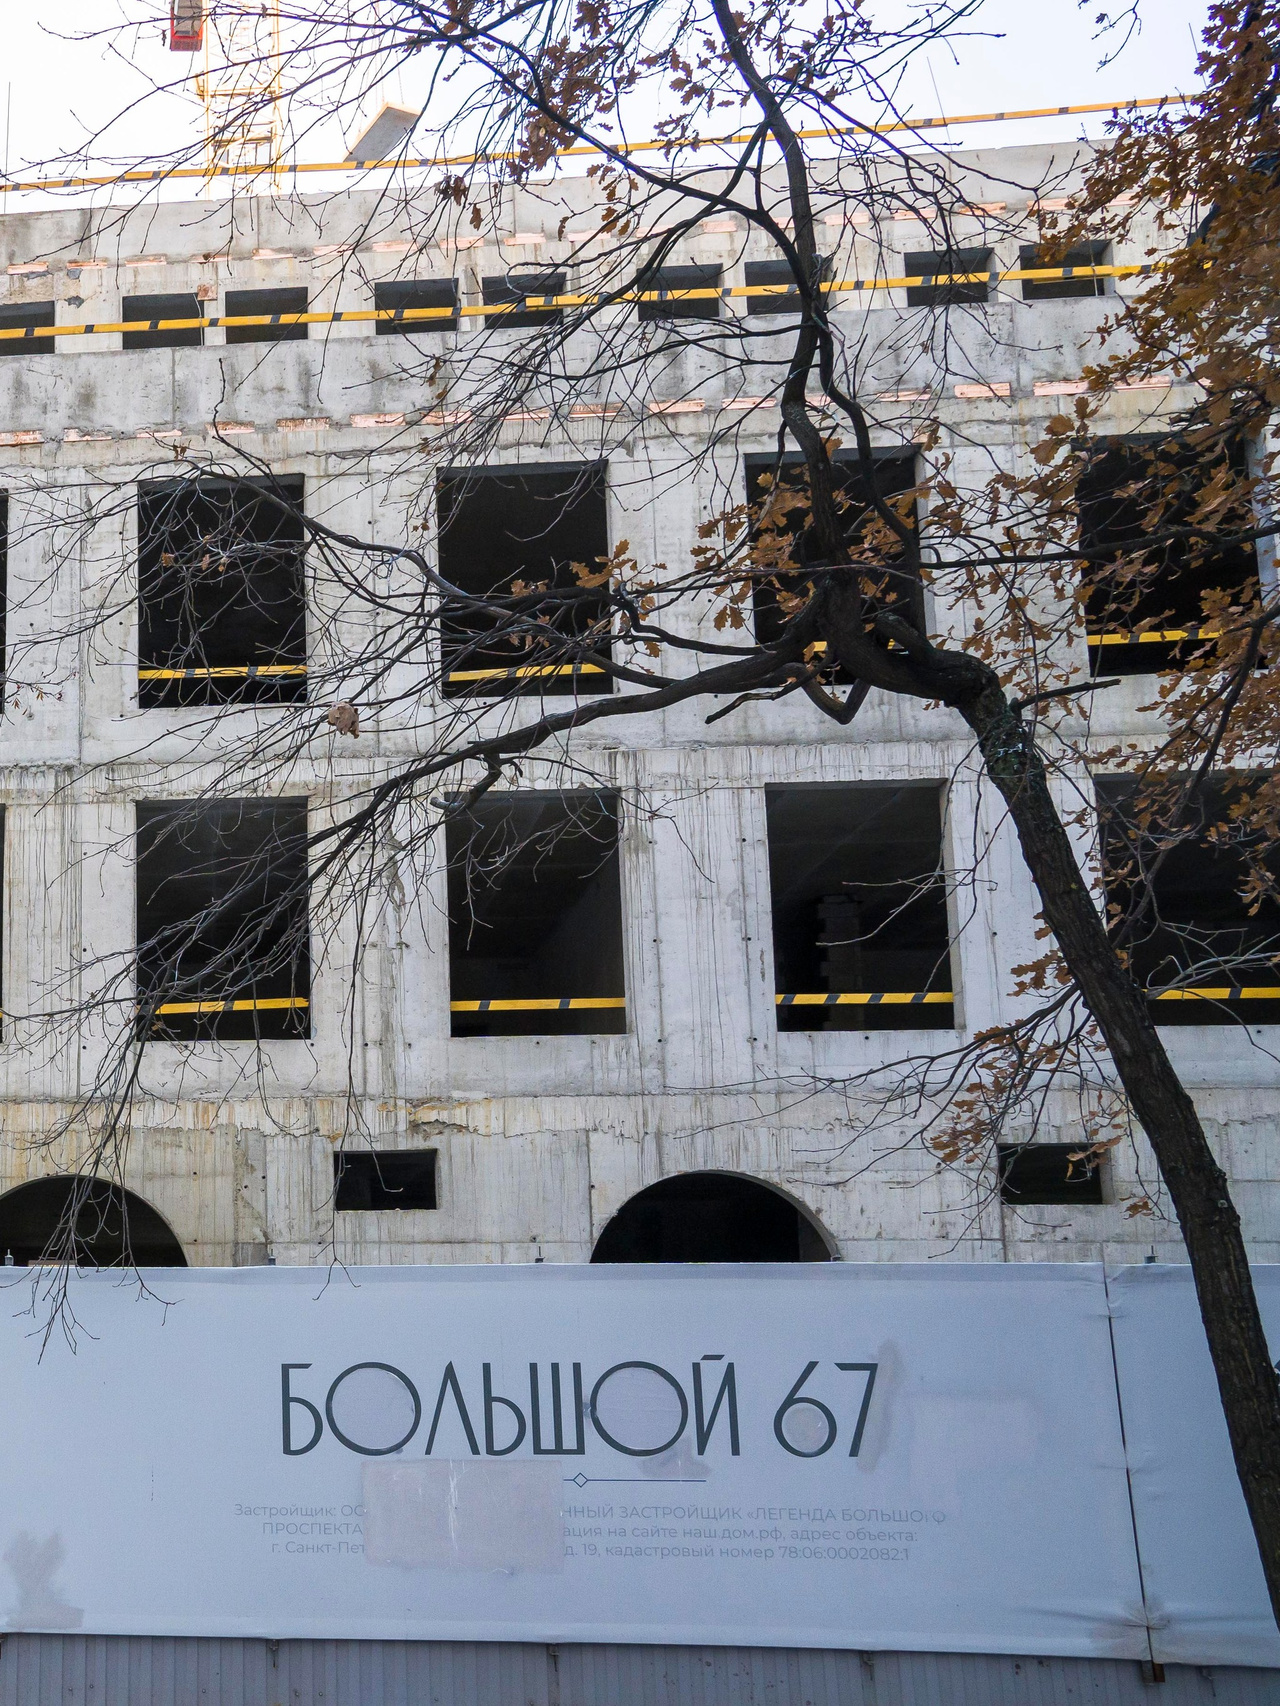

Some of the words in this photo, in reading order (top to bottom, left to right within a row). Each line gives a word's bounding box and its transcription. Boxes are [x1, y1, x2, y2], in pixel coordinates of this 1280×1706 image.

[281, 1354, 740, 1456] БОЛЬШОЙ
[774, 1361, 878, 1458] 67
[234, 1503, 336, 1518] Застройщик:
[619, 1504, 742, 1522] ЗАСТРОЙЩИК
[747, 1507, 837, 1523] «ЛЕГЕНДА
[262, 1522, 363, 1535] ПРОСПЕКТА
[608, 1527, 627, 1537] на
[631, 1525, 678, 1538] сайте
[683, 1526, 786, 1542] наш.дом.рф,
[790, 1529, 841, 1542] адрес
[845, 1527, 918, 1542] объекта:
[271, 1543, 282, 1553] г.
[563, 1545, 578, 1557] д.
[582, 1543, 601, 1557] 19,
[605, 1545, 714, 1560] кадастровый
[719, 1547, 774, 1561] номер
[778, 1546, 909, 1561] 78:06:0002082:1
